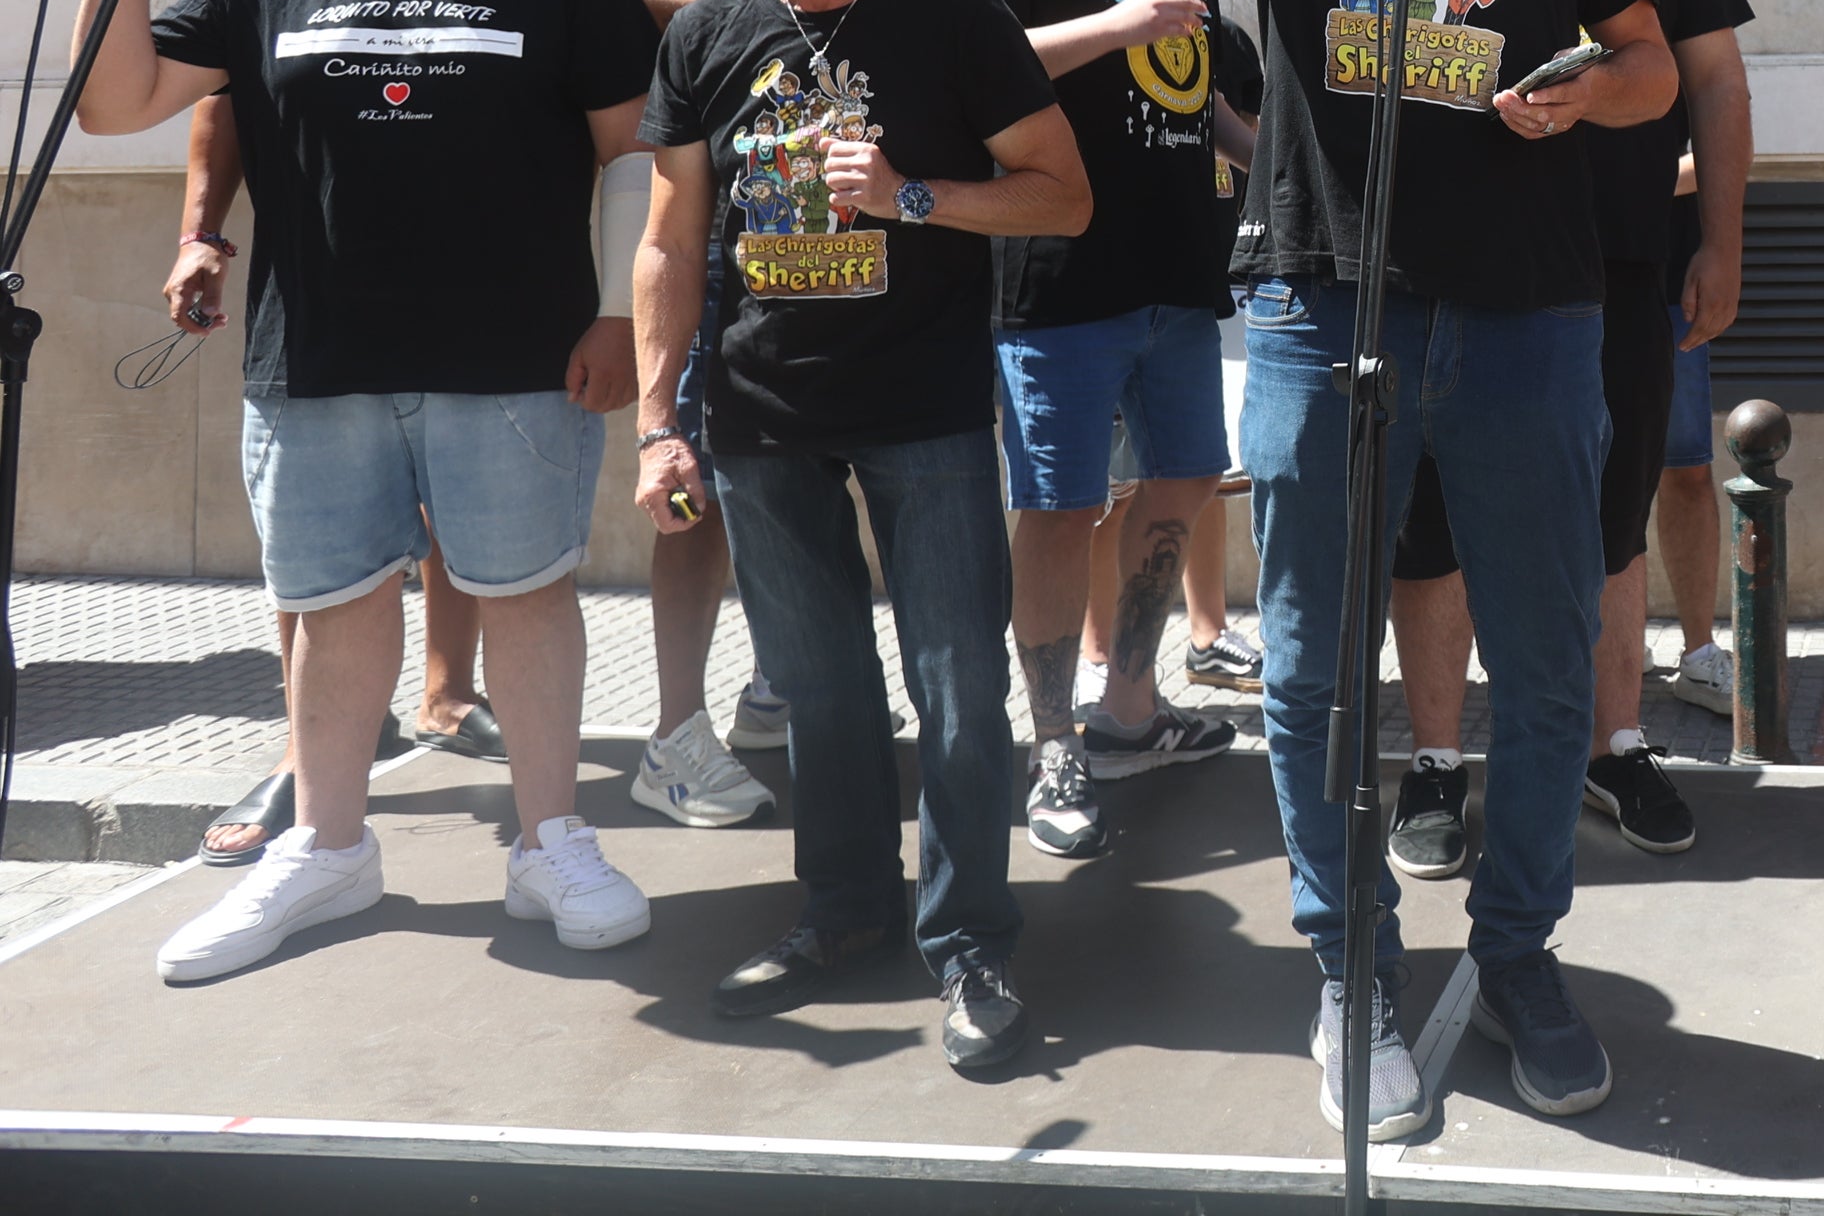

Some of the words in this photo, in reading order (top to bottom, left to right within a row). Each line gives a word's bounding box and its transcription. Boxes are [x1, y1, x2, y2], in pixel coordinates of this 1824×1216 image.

[307, 0, 391, 25] LOQUITO
[392, 0, 432, 18] POR
[433, 1, 497, 21] VERTE
[366, 36, 376, 46] a
[383, 35, 403, 46] mi
[408, 35, 436, 47] vera
[1339, 17, 1363, 36] Las
[1365, 17, 1490, 56] Chrigotas
[324, 58, 423, 76] Cariñito
[1336, 44, 1488, 96] Shriff
[747, 238, 771, 254] Las
[774, 235, 876, 256] Chirigotas
[798, 255, 819, 268] del
[745, 257, 876, 292] Sheriff
